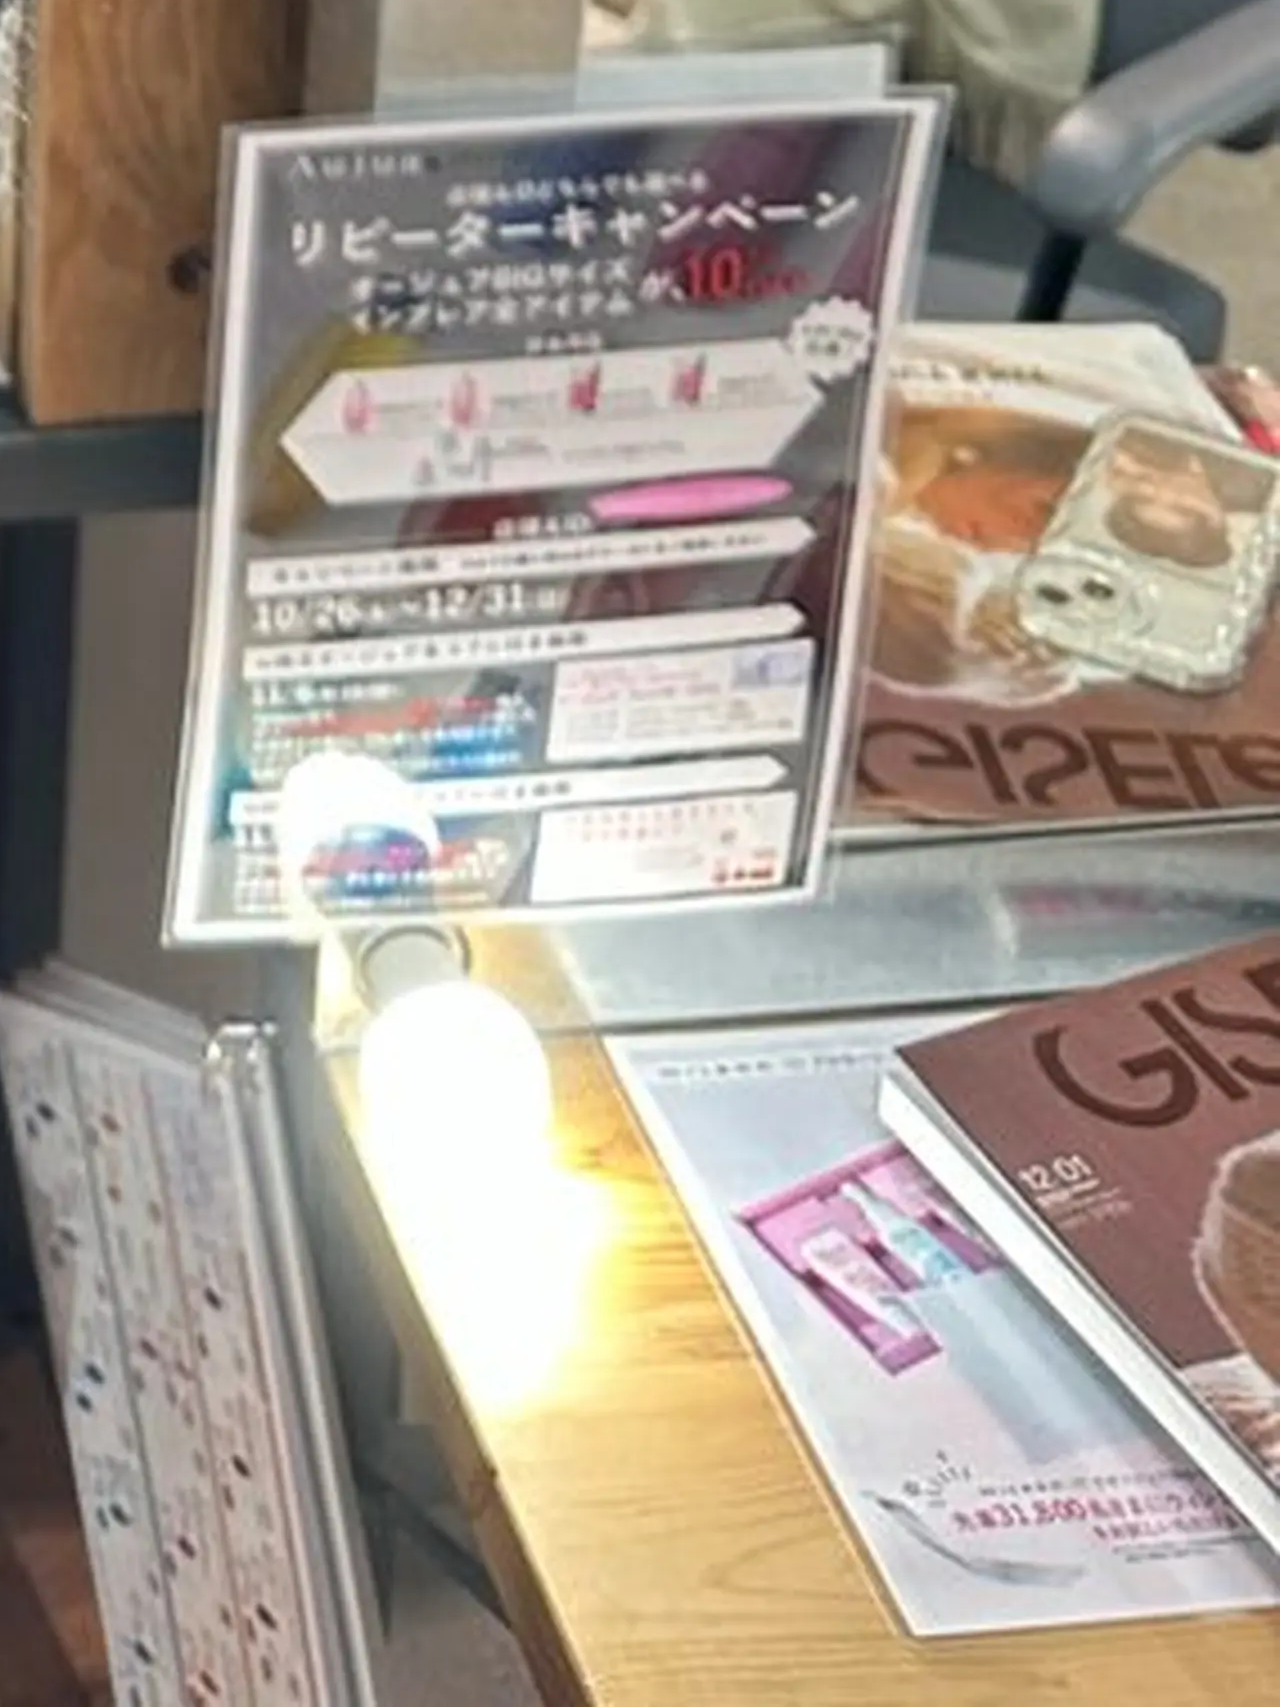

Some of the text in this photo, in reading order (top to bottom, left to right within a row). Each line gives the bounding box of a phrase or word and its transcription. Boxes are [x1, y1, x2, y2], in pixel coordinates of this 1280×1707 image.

[290, 190, 860, 266] リピーターキャンペーン
